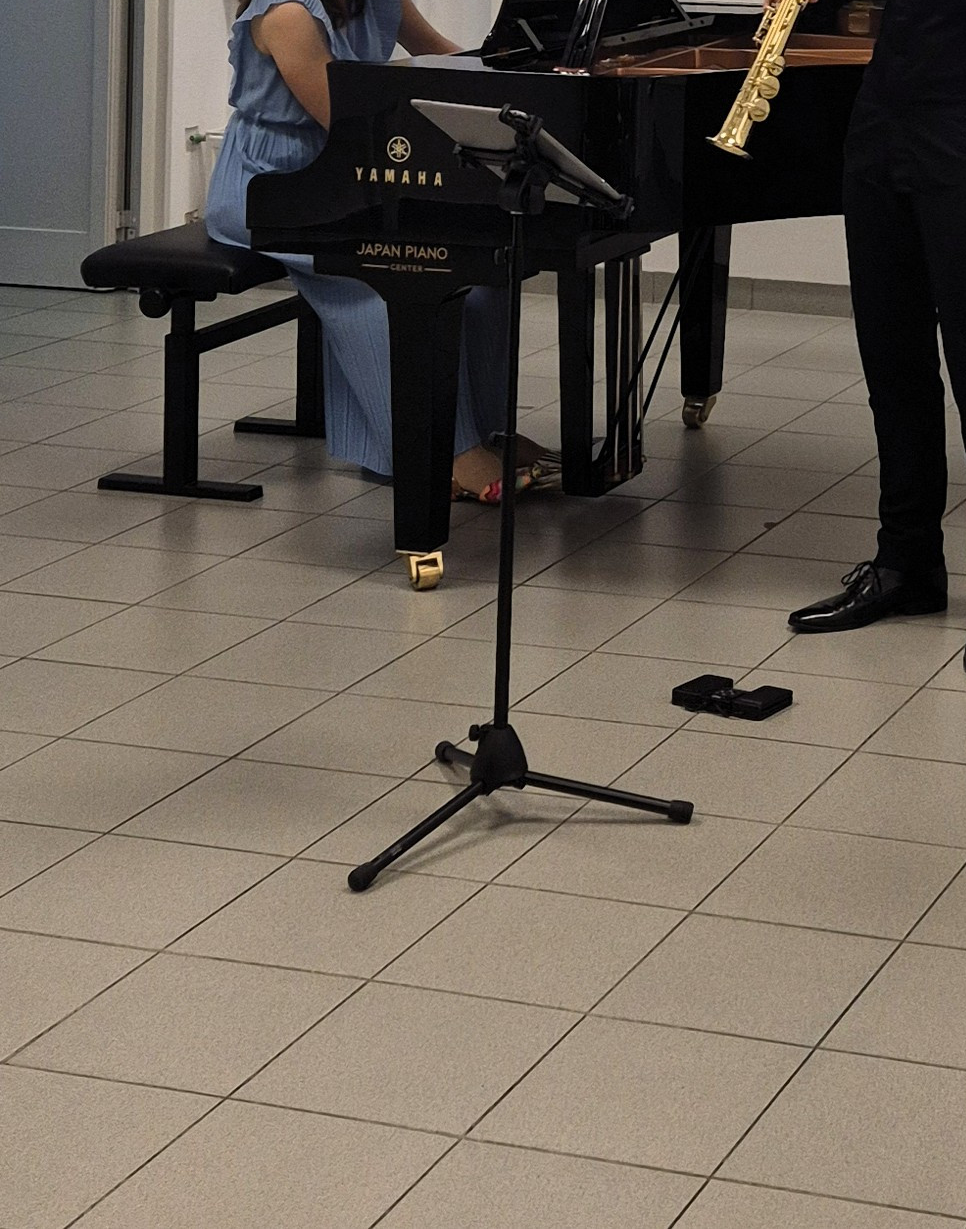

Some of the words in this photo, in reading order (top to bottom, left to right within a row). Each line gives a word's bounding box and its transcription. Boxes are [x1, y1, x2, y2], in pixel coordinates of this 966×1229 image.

[355, 166, 443, 187] YAMAHA
[356, 242, 401, 258] JAPAN
[405, 245, 449, 260] PIANO
[389, 263, 424, 273] CENTER
